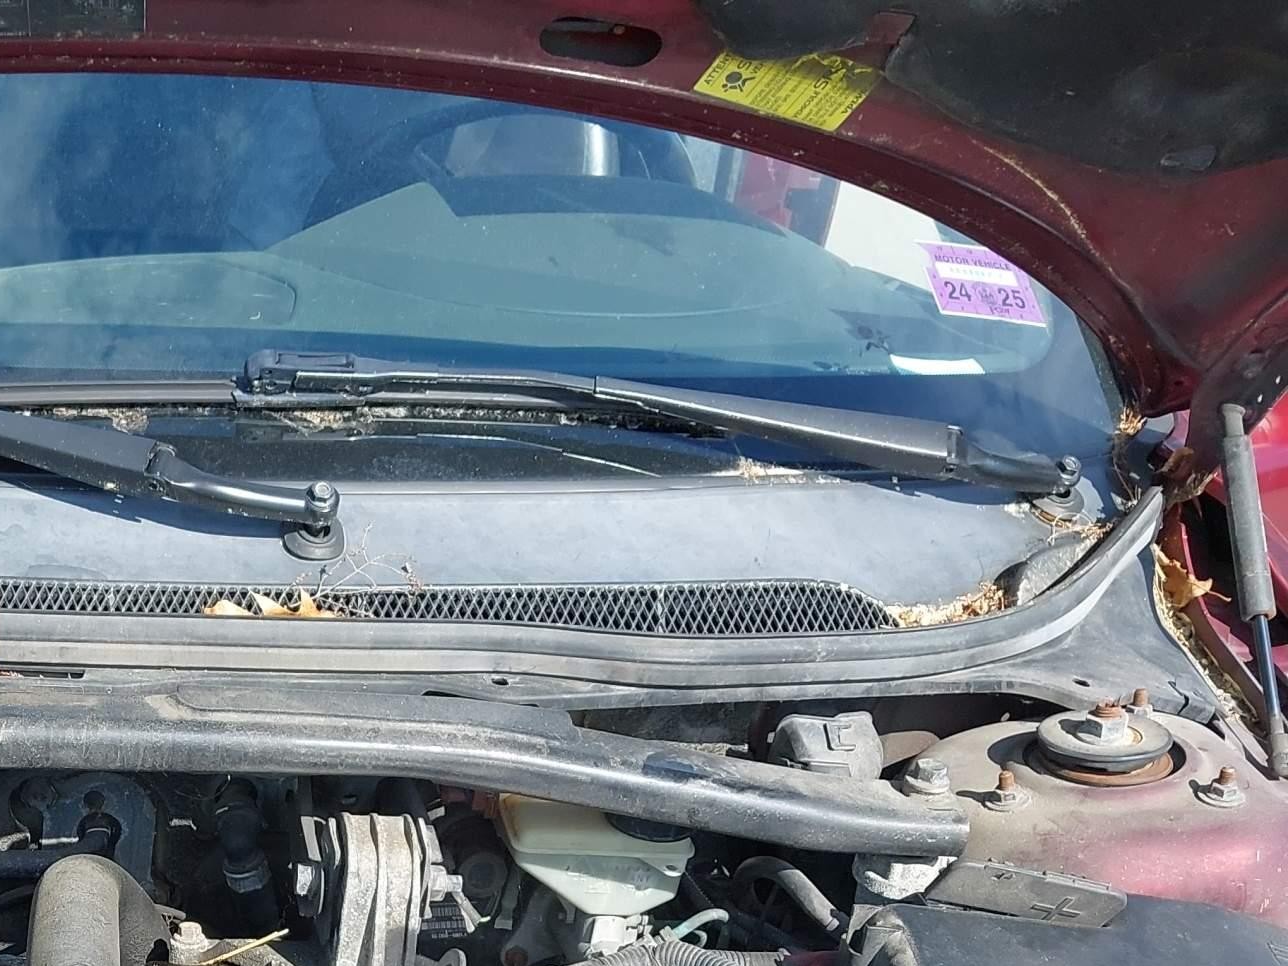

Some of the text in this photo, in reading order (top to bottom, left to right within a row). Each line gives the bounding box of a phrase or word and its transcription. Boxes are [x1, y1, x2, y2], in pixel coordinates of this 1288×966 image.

[934, 253, 1012, 272] MOTOR VEHICLE
[943, 281, 1026, 309] 24 25
